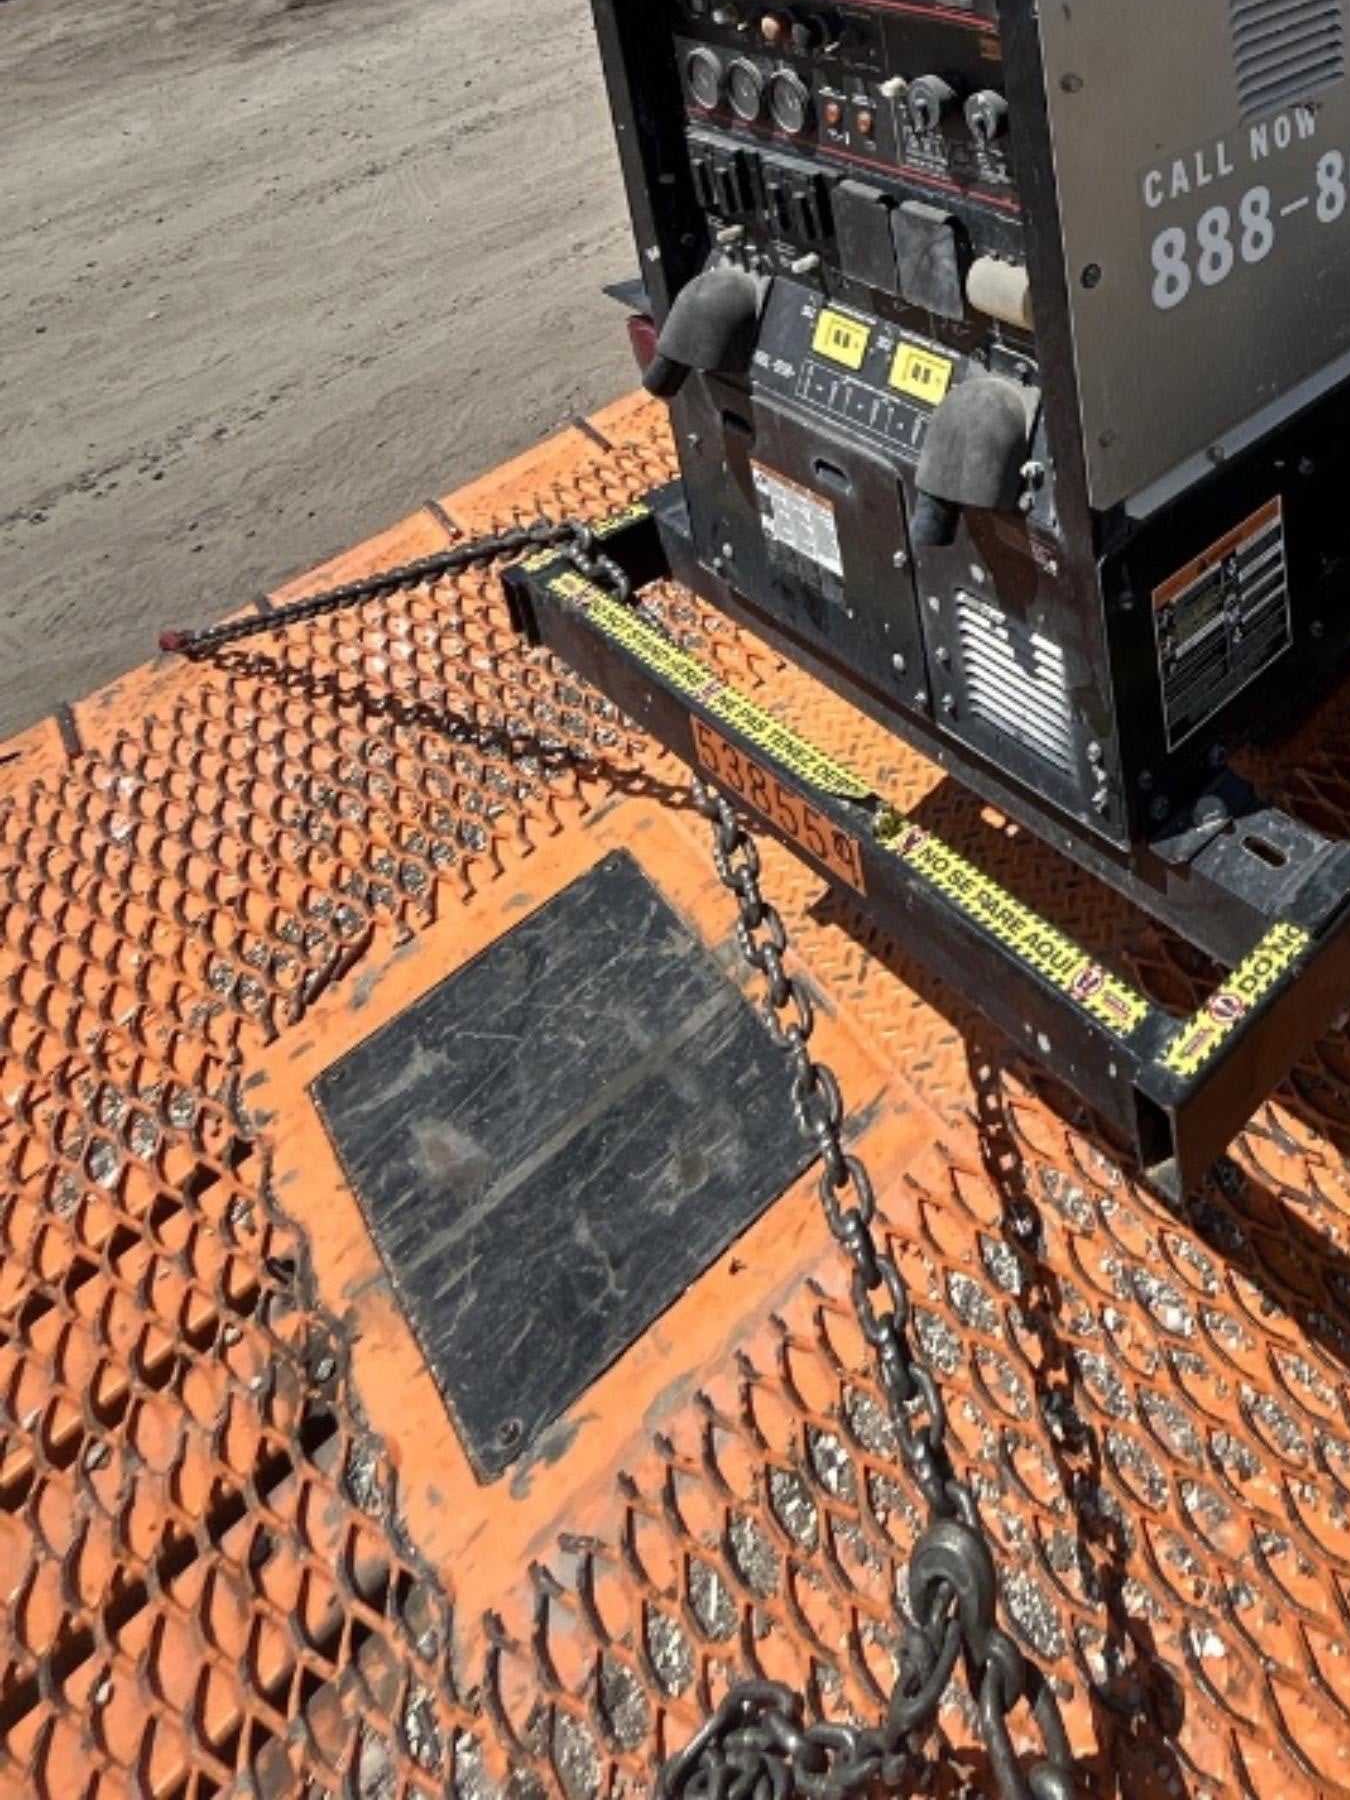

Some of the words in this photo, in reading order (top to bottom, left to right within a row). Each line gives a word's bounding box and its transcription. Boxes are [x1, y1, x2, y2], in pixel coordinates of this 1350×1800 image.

[1143, 143, 1235, 209] CALL
[1249, 105, 1320, 161] NOW
[735, 707, 769, 733] PAS
[766, 727, 817, 767] TENEZ
[696, 720, 860, 887] 538559
[917, 844, 951, 873] NO
[948, 868, 978, 894] SE
[975, 888, 1027, 936] PARE
[1236, 955, 1274, 993] DO
